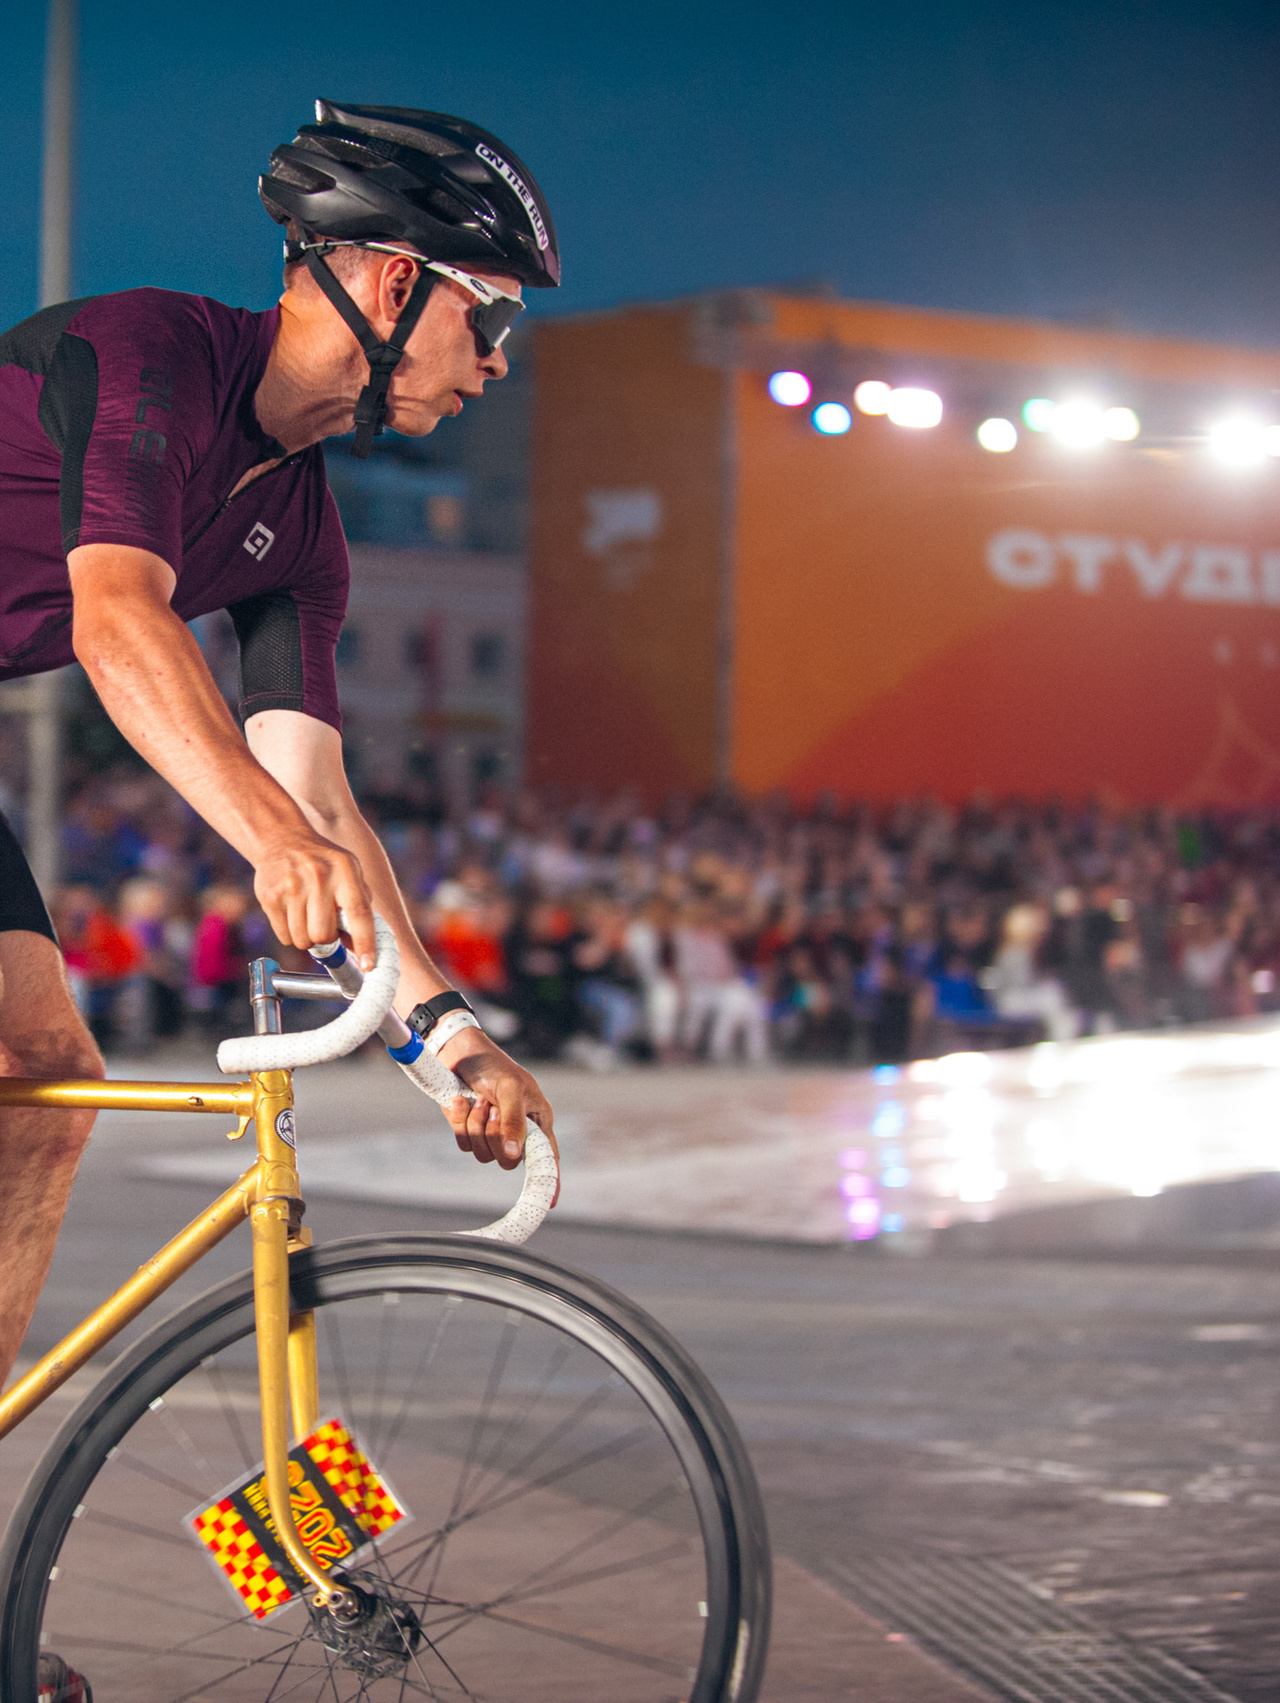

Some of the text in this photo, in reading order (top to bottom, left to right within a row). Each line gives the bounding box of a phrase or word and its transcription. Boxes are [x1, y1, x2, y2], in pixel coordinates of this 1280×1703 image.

[479, 146, 548, 248] ON THE RUN
